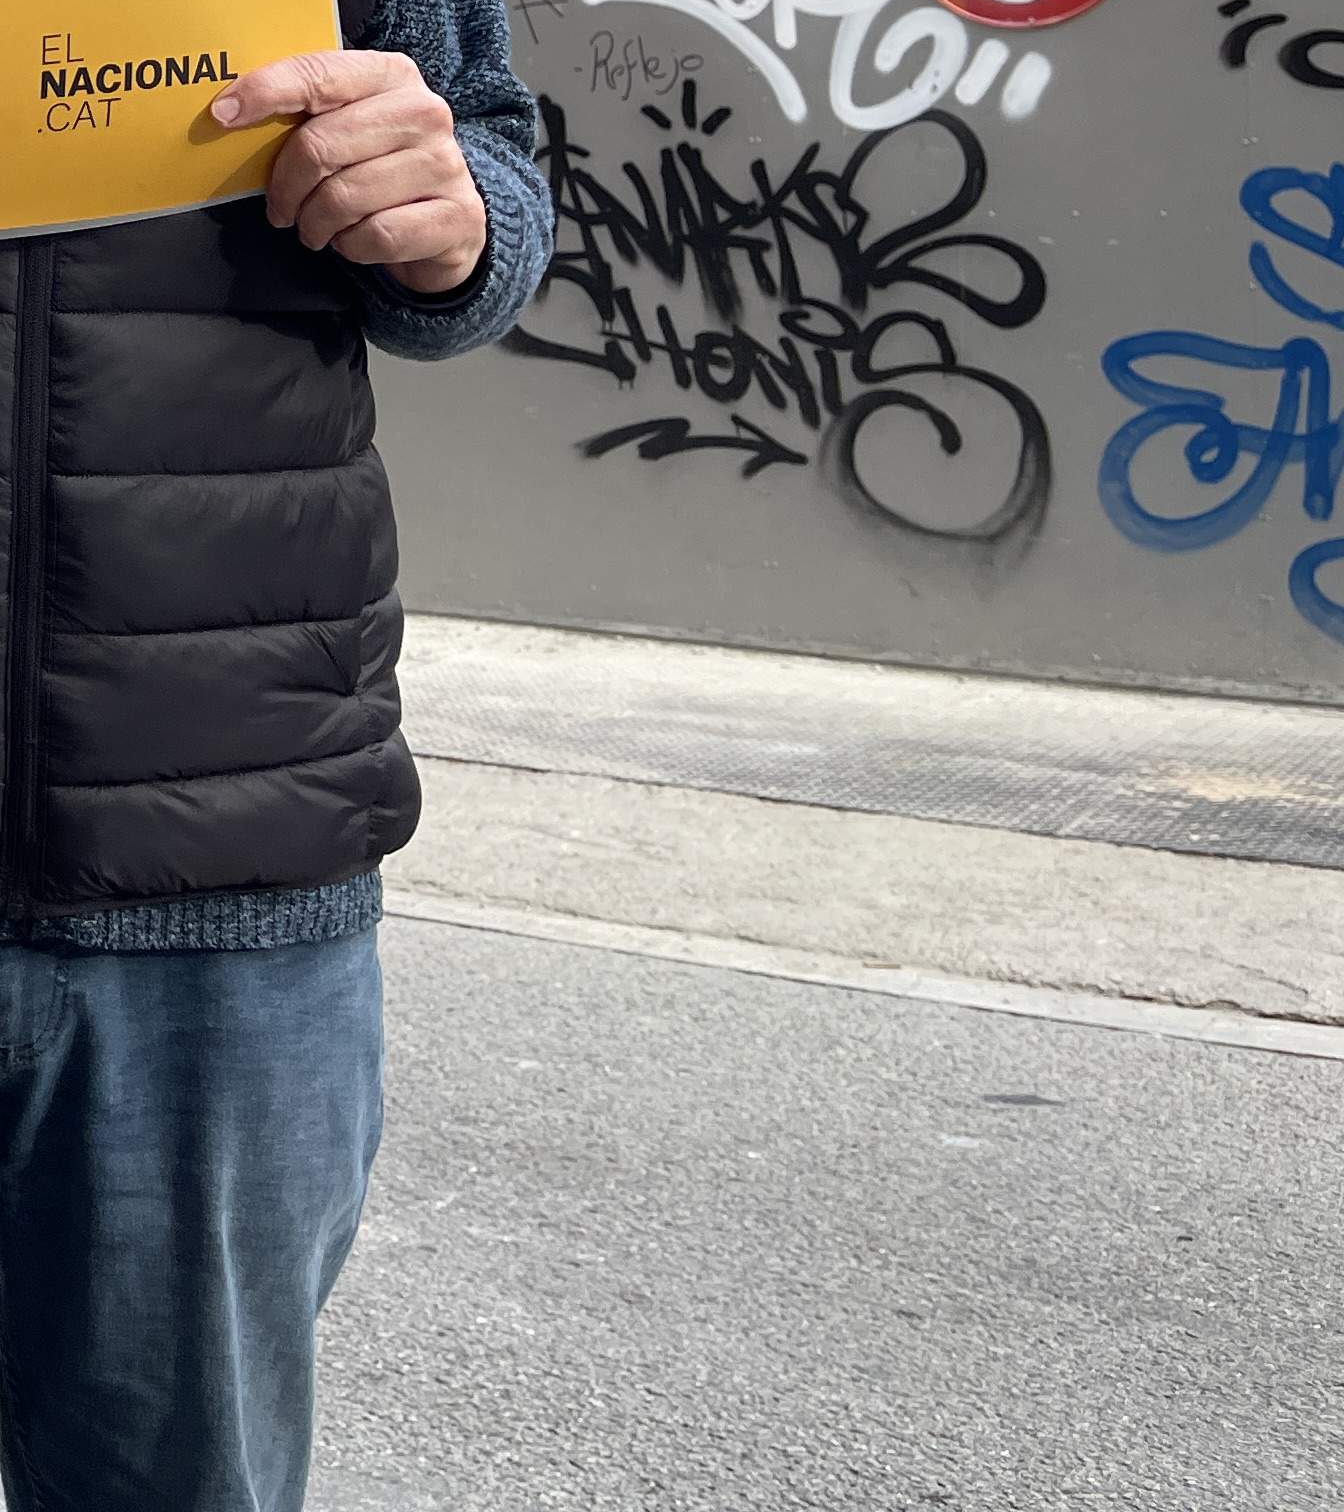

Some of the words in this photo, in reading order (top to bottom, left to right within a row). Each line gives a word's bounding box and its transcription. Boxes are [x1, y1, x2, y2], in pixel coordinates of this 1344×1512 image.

[41, 33, 85, 66] EL
[40, 51, 239, 100] NACIONAL
[36, 97, 122, 134] .CAT
